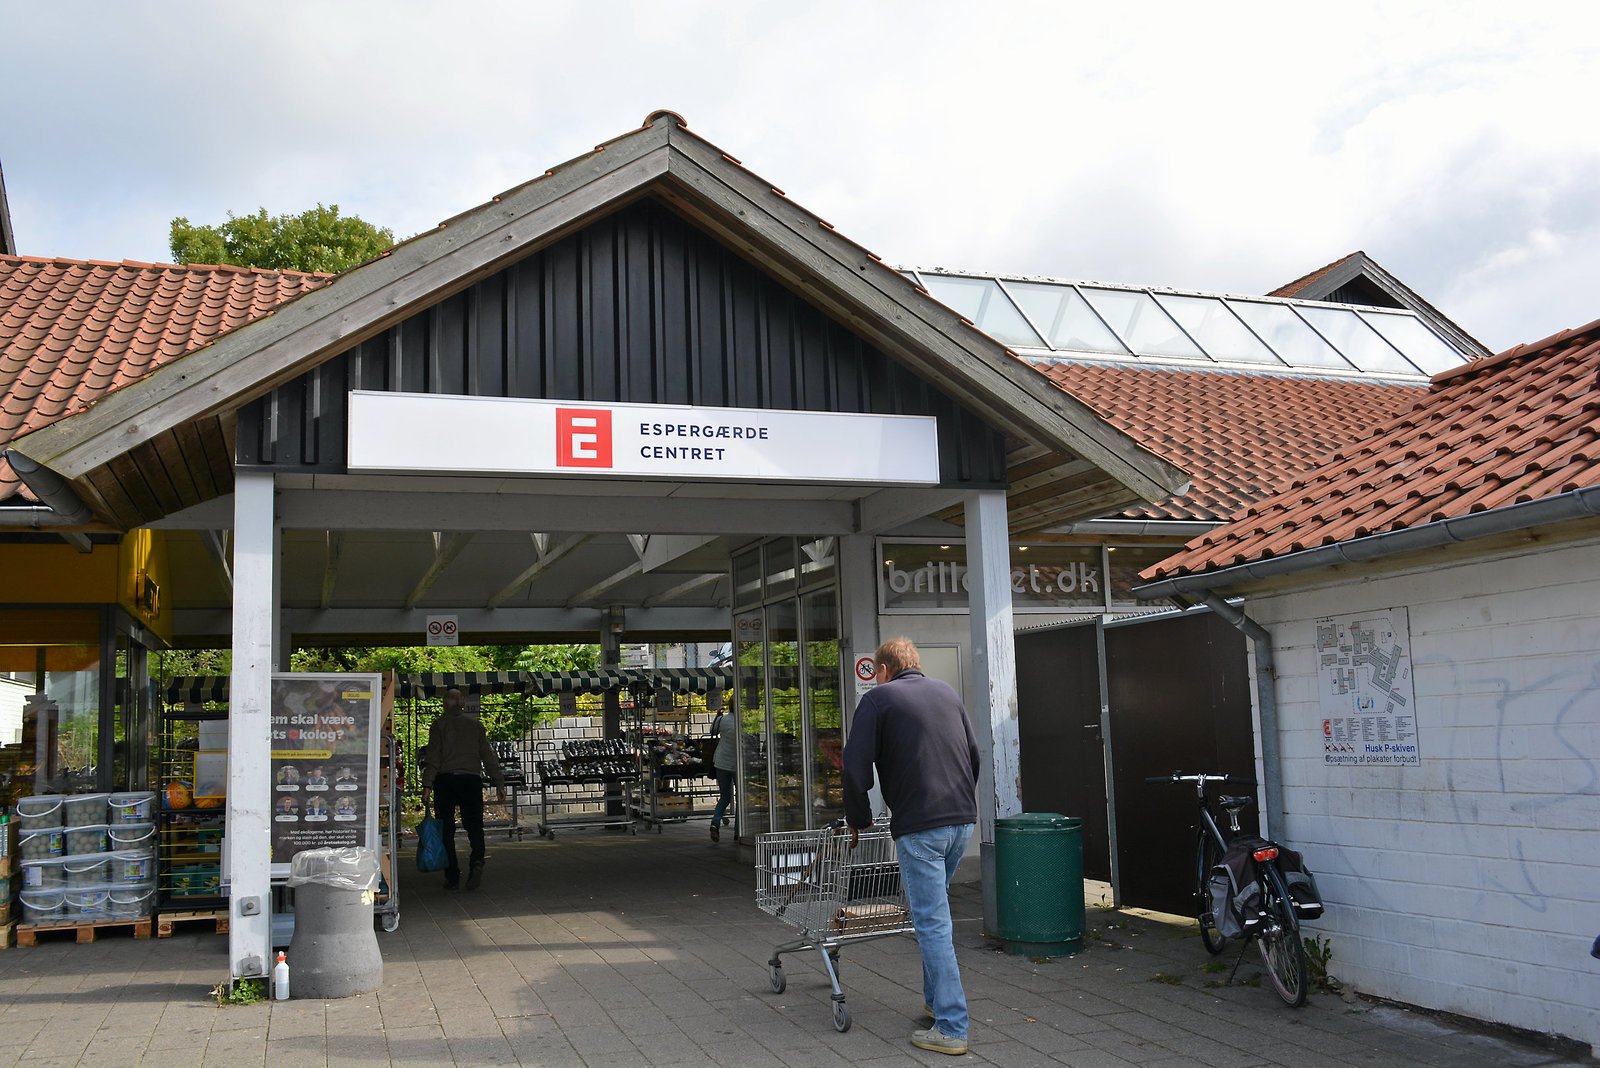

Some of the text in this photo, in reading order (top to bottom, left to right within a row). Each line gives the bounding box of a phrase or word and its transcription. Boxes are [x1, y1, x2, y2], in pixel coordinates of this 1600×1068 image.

[640, 423, 769, 440] ESPERGÆRDE
[640, 446, 726, 461] CENTRET
[290, 714, 318, 725] skal
[321, 715, 355, 725] være
[1365, 742, 1416, 753] Husk P-skiven
[1358, 754, 1365, 763] af
[1366, 754, 1392, 765] plakater
[1393, 753, 1418, 763] forbudt
